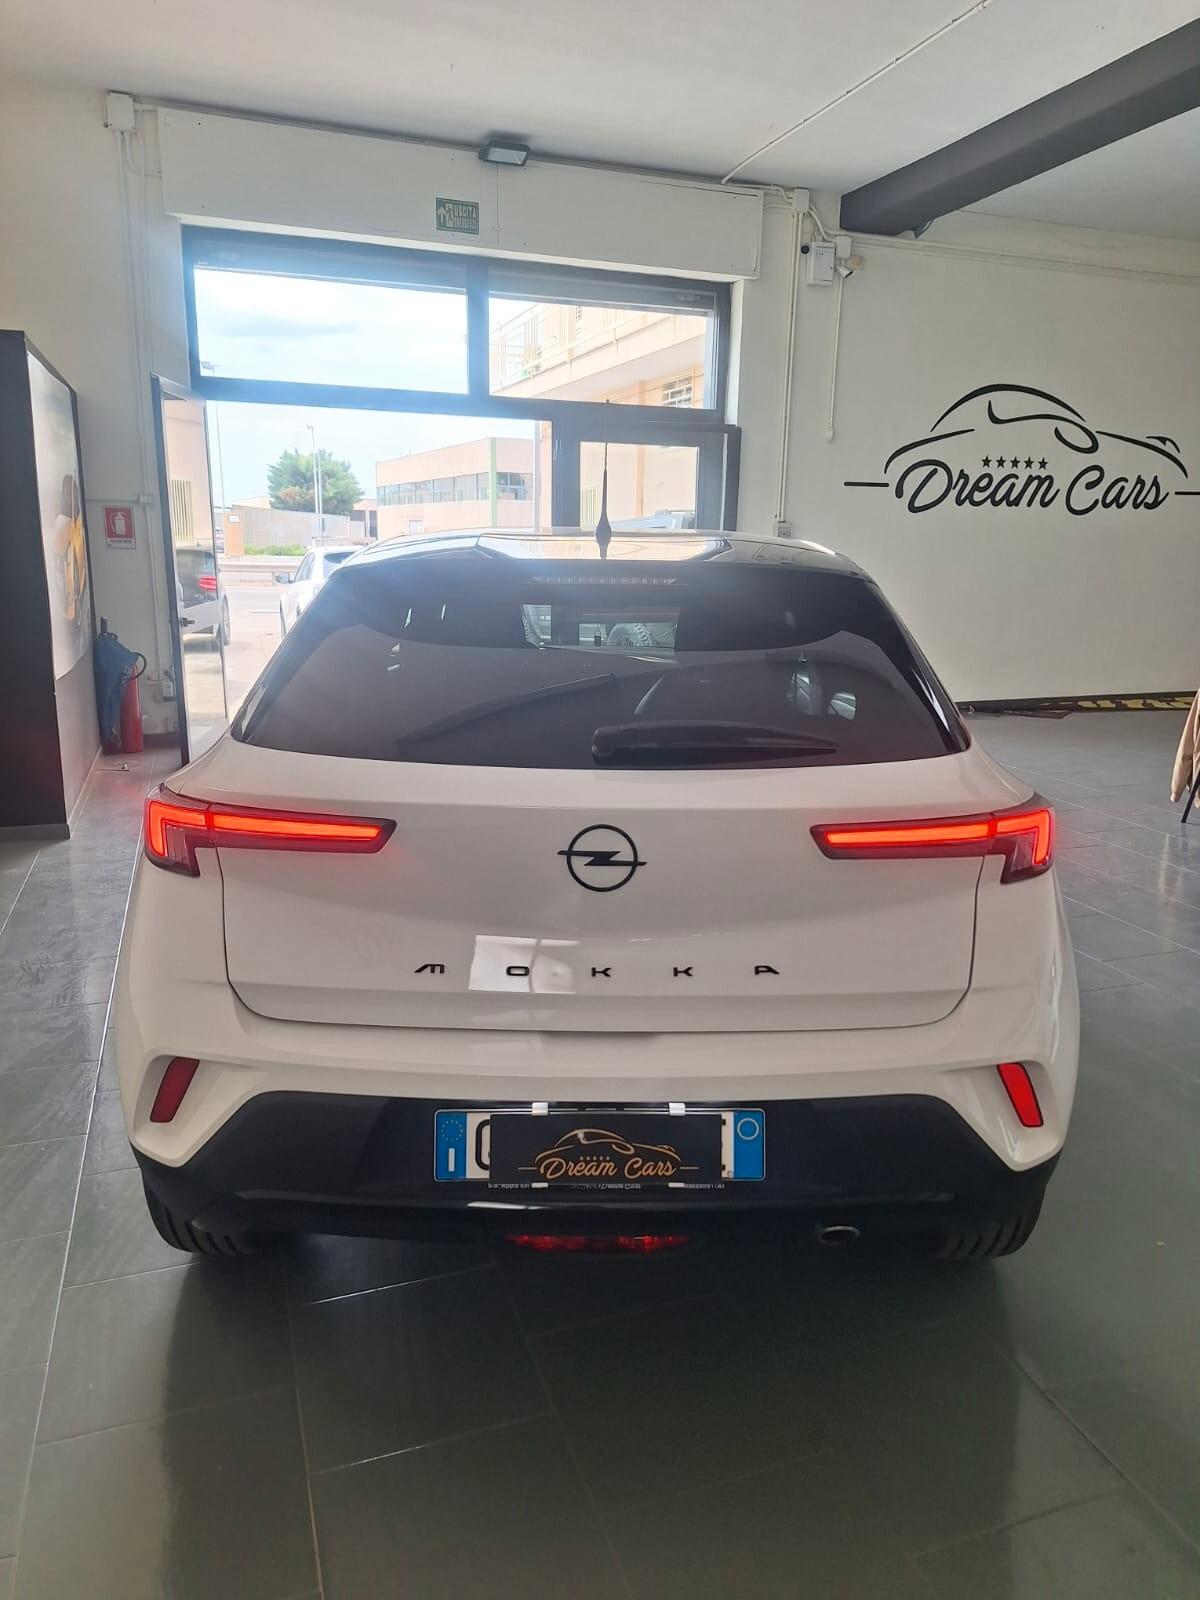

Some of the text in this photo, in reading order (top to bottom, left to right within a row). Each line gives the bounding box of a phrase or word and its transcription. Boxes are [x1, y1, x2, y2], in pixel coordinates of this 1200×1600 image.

[454, 203, 477, 218] USCITA
[895, 459, 1169, 516] Dream Cars
[414, 963, 780, 977] MOKKA
[539, 1157, 677, 1180] Dream Cars
